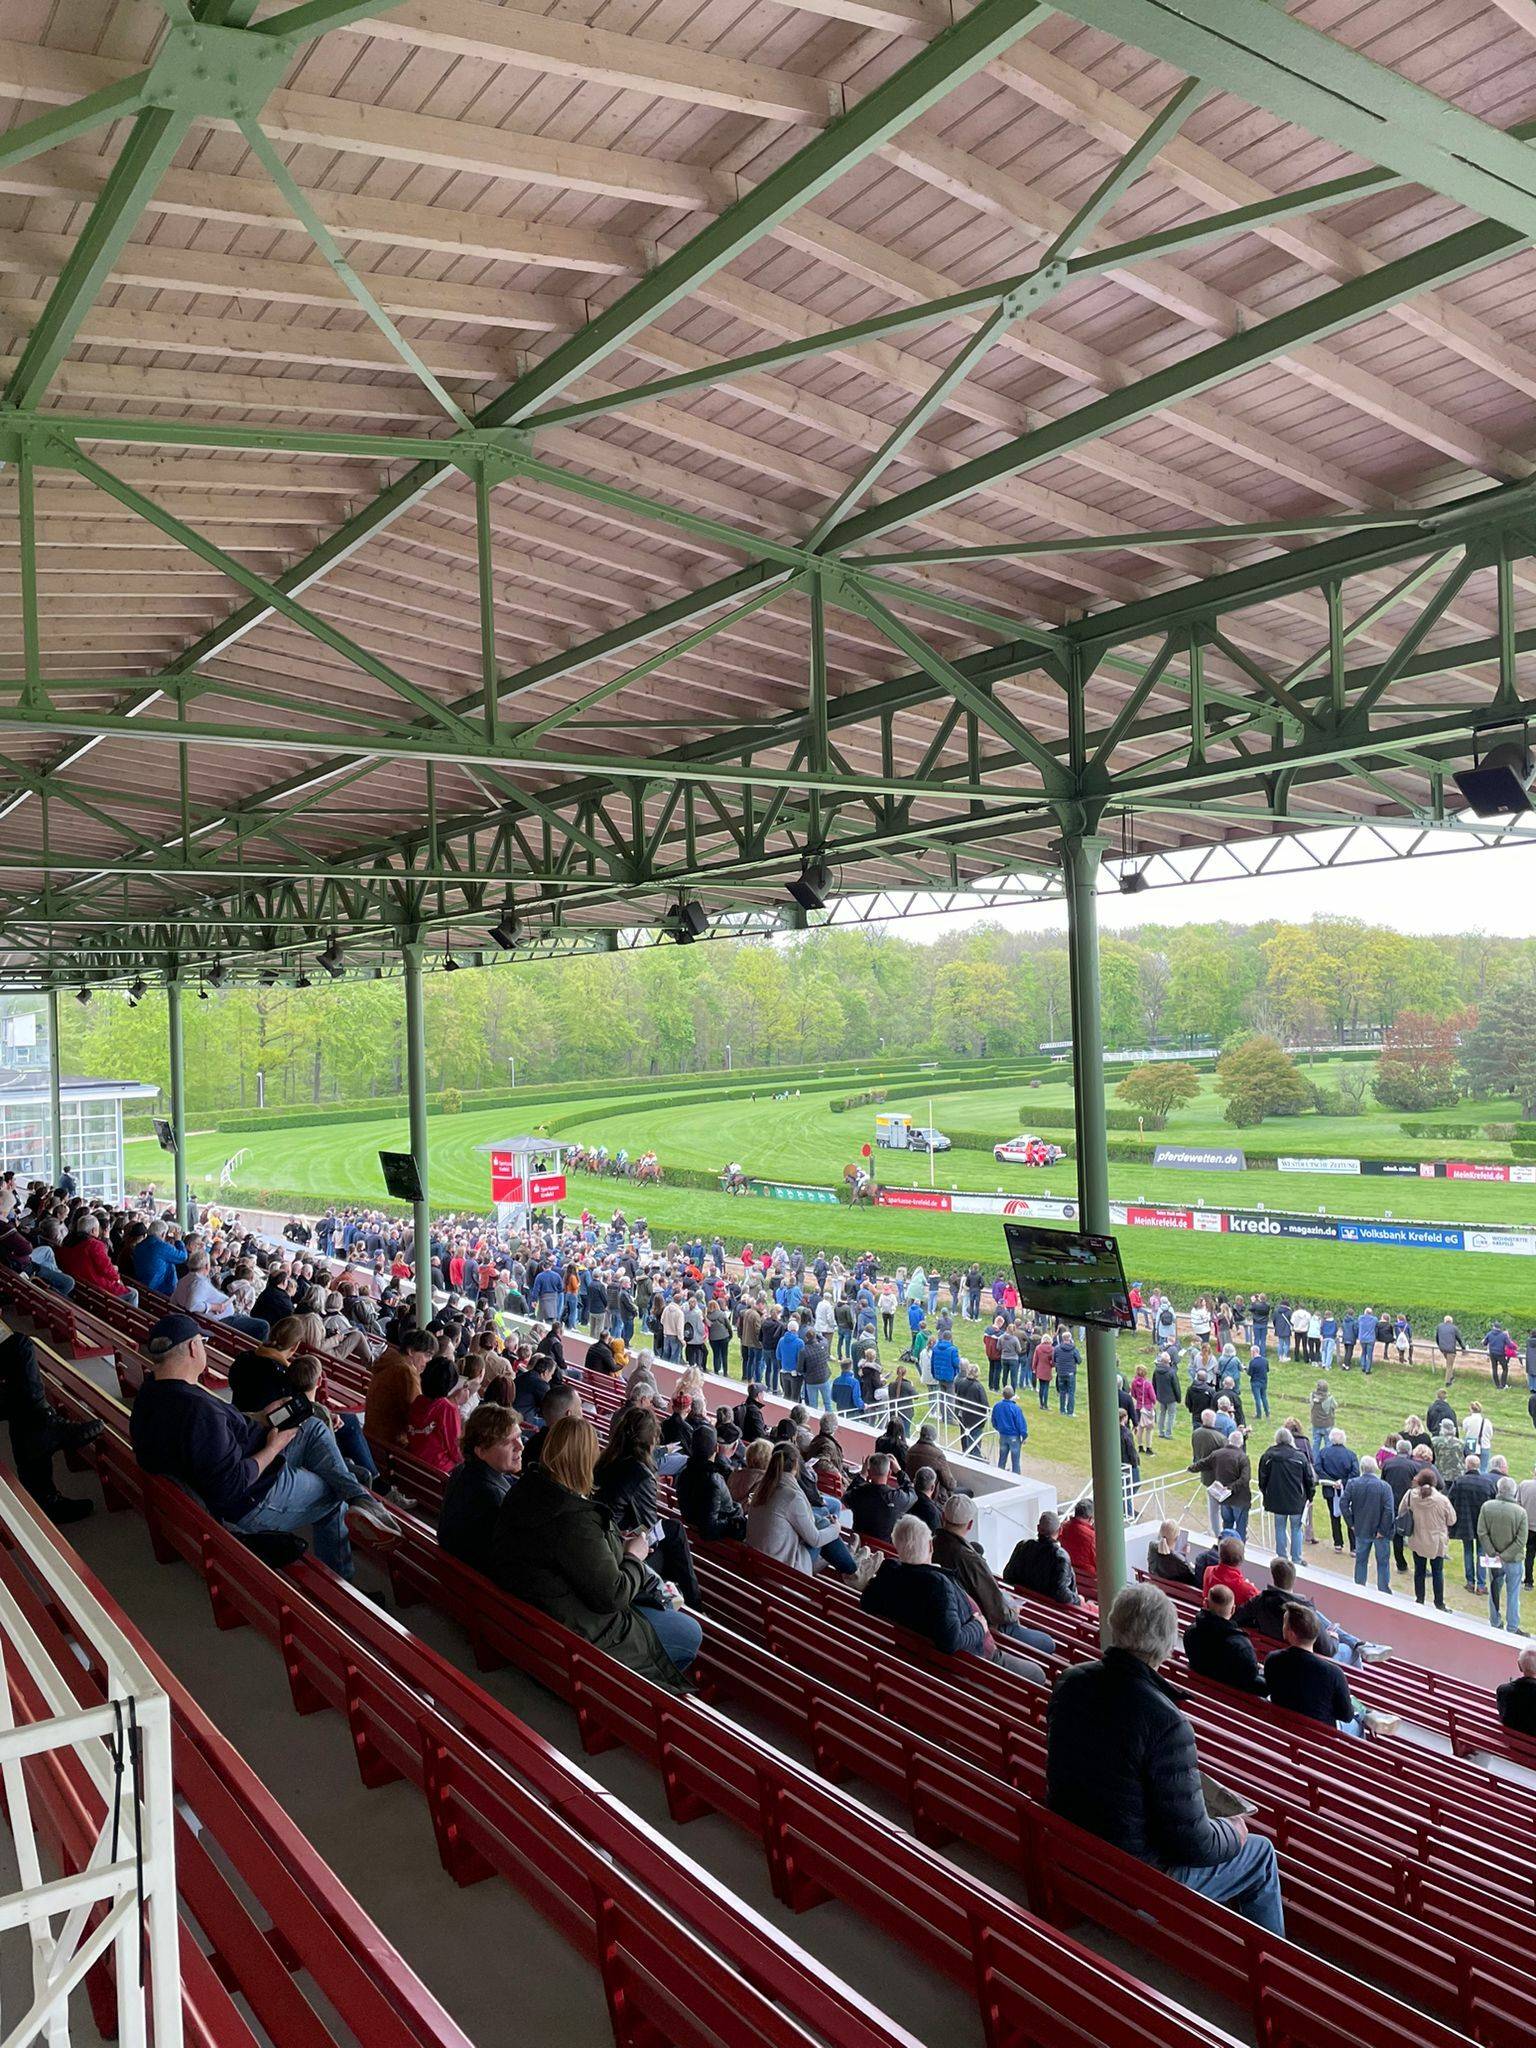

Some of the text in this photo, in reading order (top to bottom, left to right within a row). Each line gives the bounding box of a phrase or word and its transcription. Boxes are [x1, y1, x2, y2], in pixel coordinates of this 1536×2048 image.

[1156, 1151, 1238, 1165] pferdewetten.de
[1134, 1216, 1188, 1228] MeinKrefeld.de
[1229, 1214, 1281, 1235] kredo
[1359, 1228, 1459, 1244] Volksbank Krefeld eG
